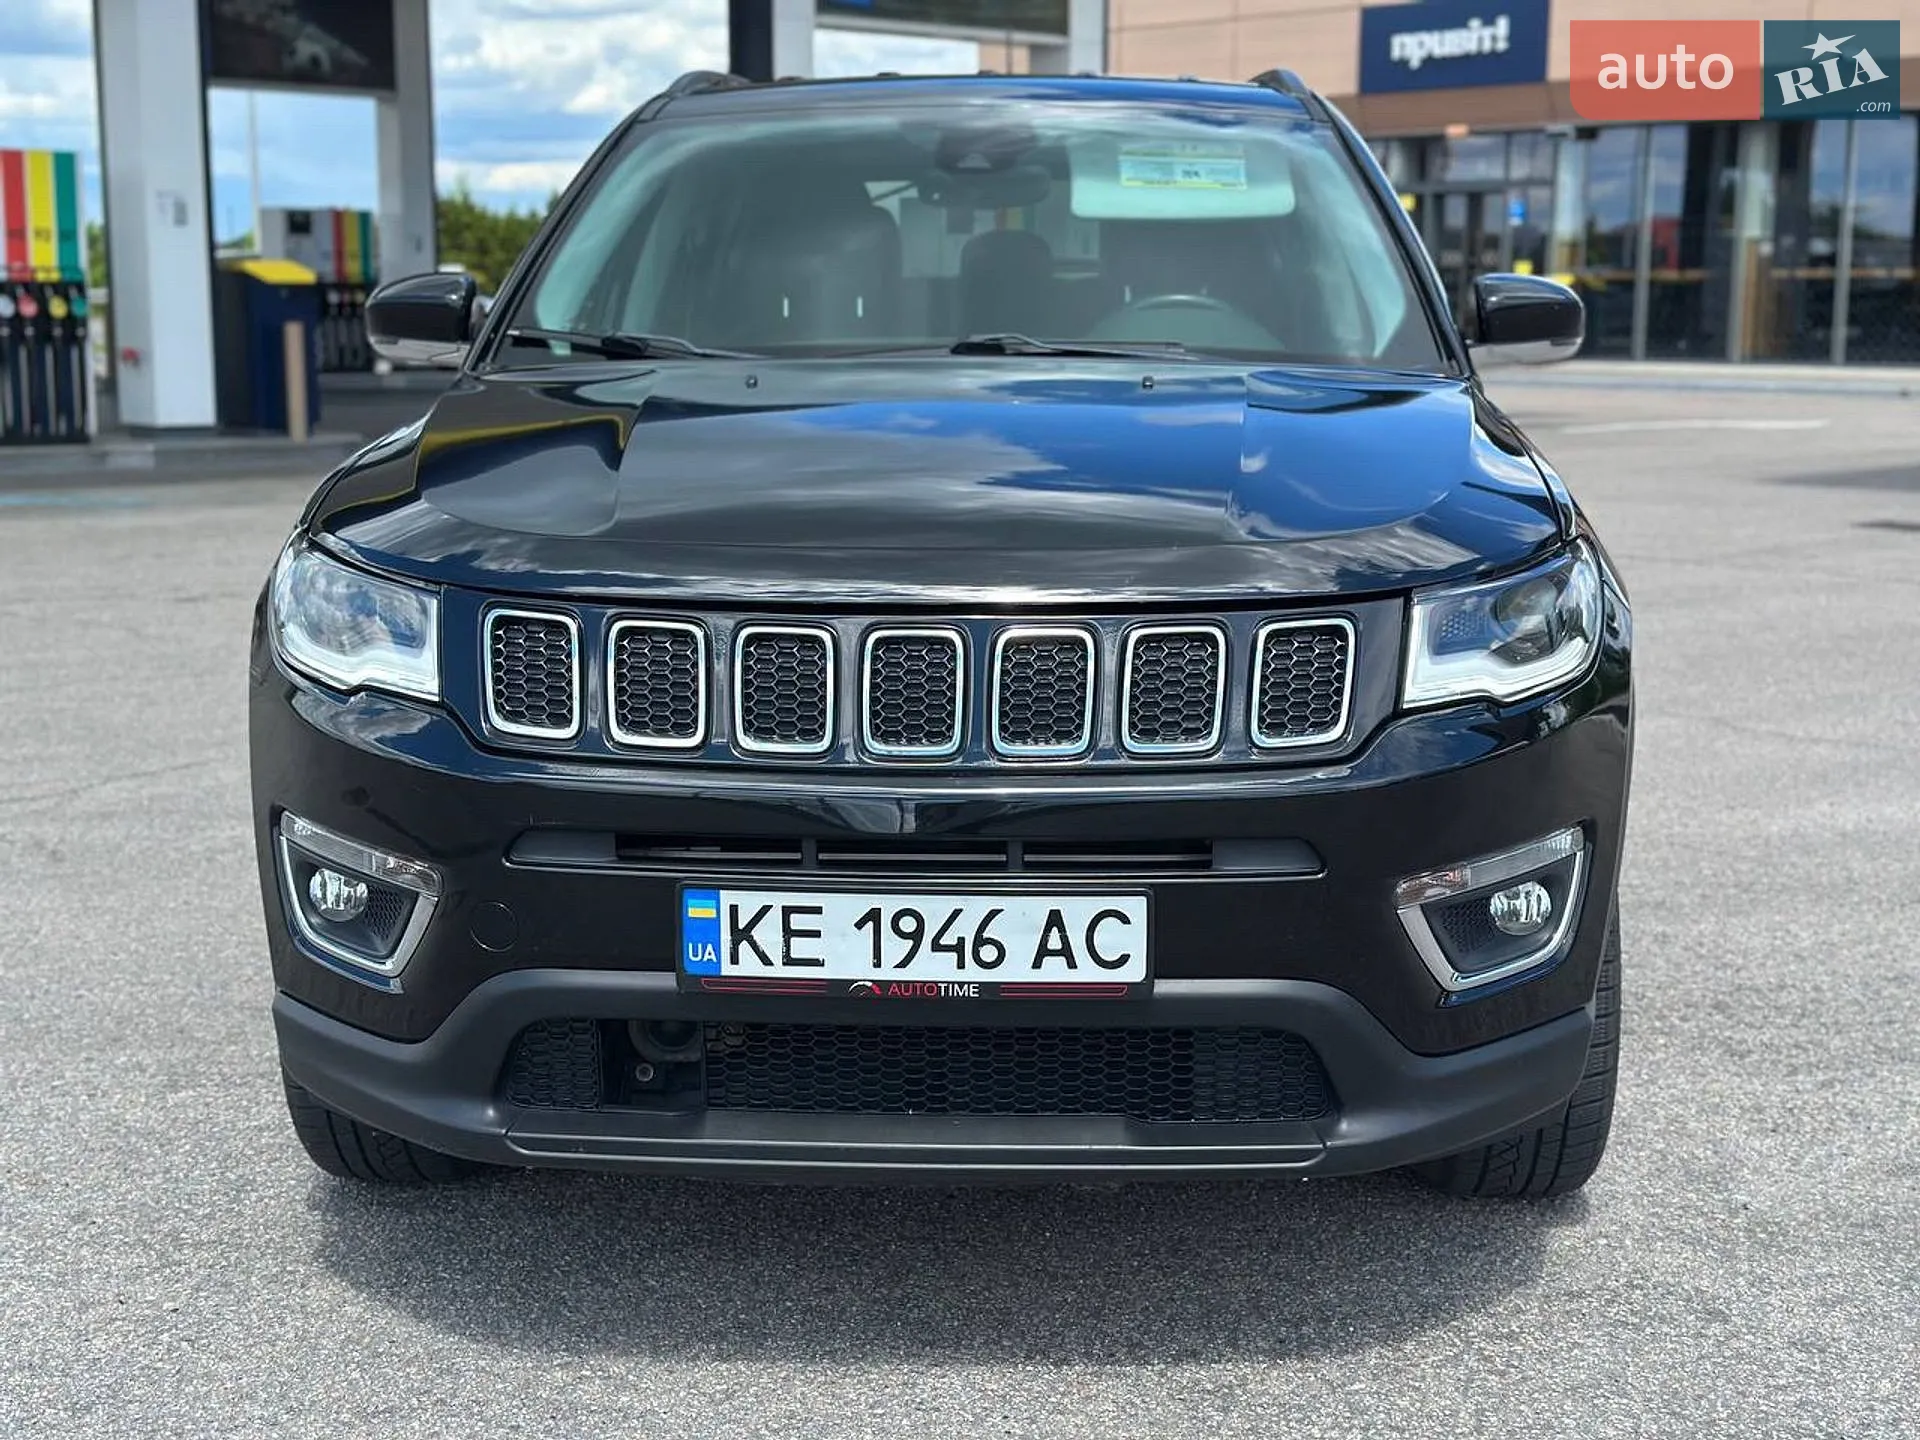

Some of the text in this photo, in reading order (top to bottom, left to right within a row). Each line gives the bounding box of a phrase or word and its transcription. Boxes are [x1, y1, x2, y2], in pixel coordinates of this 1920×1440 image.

[728, 904, 1132, 970] KE 1946 AC
[688, 945, 717, 963] UA
[887, 982, 980, 998] AUTOTIME
